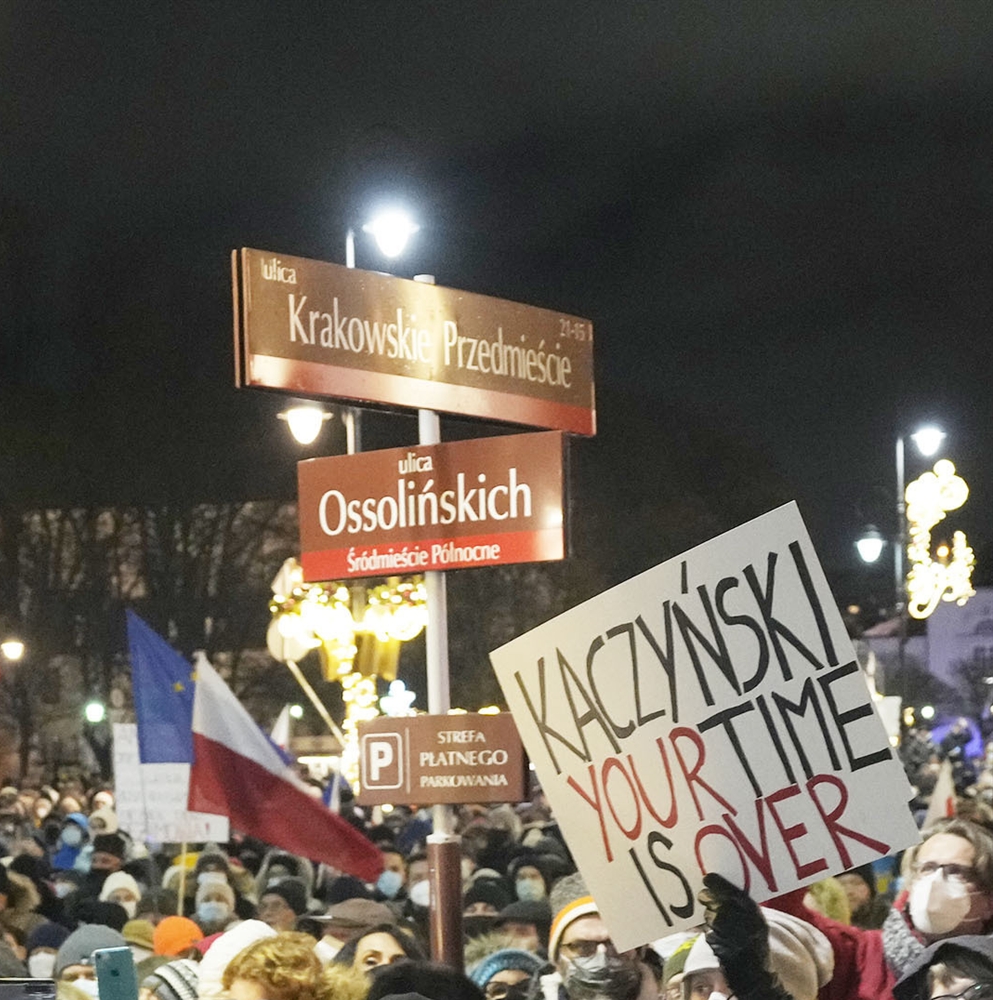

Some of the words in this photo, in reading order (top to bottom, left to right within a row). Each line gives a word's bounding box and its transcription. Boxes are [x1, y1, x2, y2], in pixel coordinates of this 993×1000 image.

[262, 258, 297, 284] ulica
[287, 293, 433, 364] Krakowskie
[443, 320, 572, 389] Przedmieście
[398, 452, 433, 475] ulica
[318, 467, 532, 537] Ossolińskich
[347, 543, 429, 573] Śródmieście
[431, 541, 500, 567] Północne
[514, 540, 840, 775] KACZYŃSKI
[437, 730, 486, 744] STREFA
[370, 741, 394, 782] P
[419, 749, 509, 767] PŁATNEGO
[567, 726, 738, 863] YOUR
[697, 660, 893, 798] TIME
[420, 774, 508, 788] PARKOWANIA
[629, 830, 695, 927] IS
[694, 773, 891, 893] OVER
